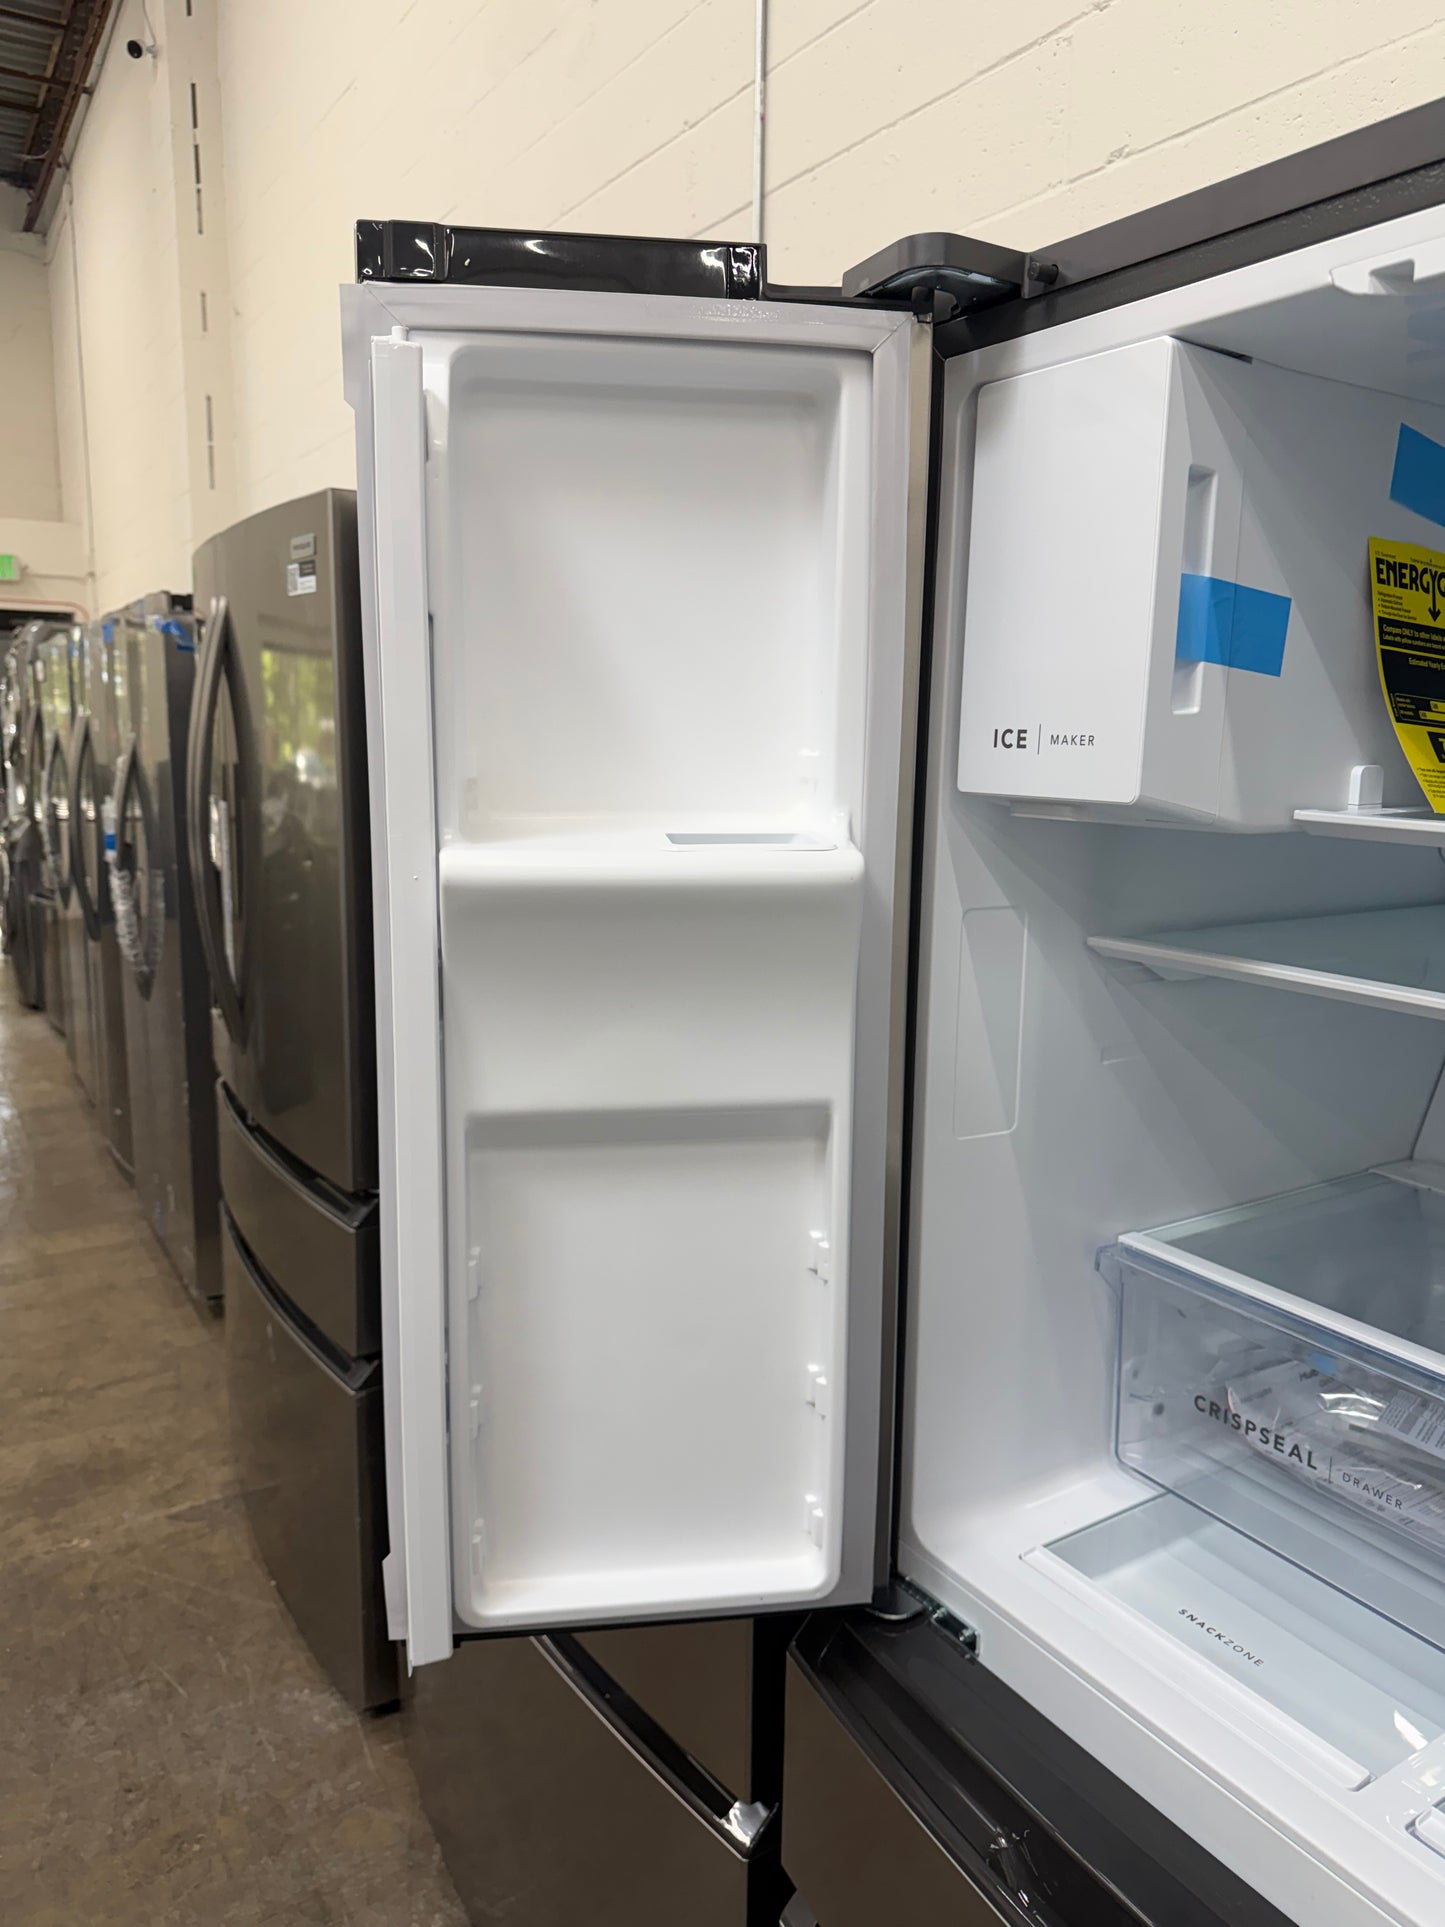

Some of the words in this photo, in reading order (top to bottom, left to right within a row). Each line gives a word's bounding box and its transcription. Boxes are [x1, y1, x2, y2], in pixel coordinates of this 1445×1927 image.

[993, 728, 1028, 749] ICE
[1050, 734, 1095, 746] MAKER
[1194, 1394, 1318, 1470] CRISPSEAL
[1342, 1472, 1403, 1510] DRAWER
[1178, 1608, 1264, 1667] SNACKZONE
